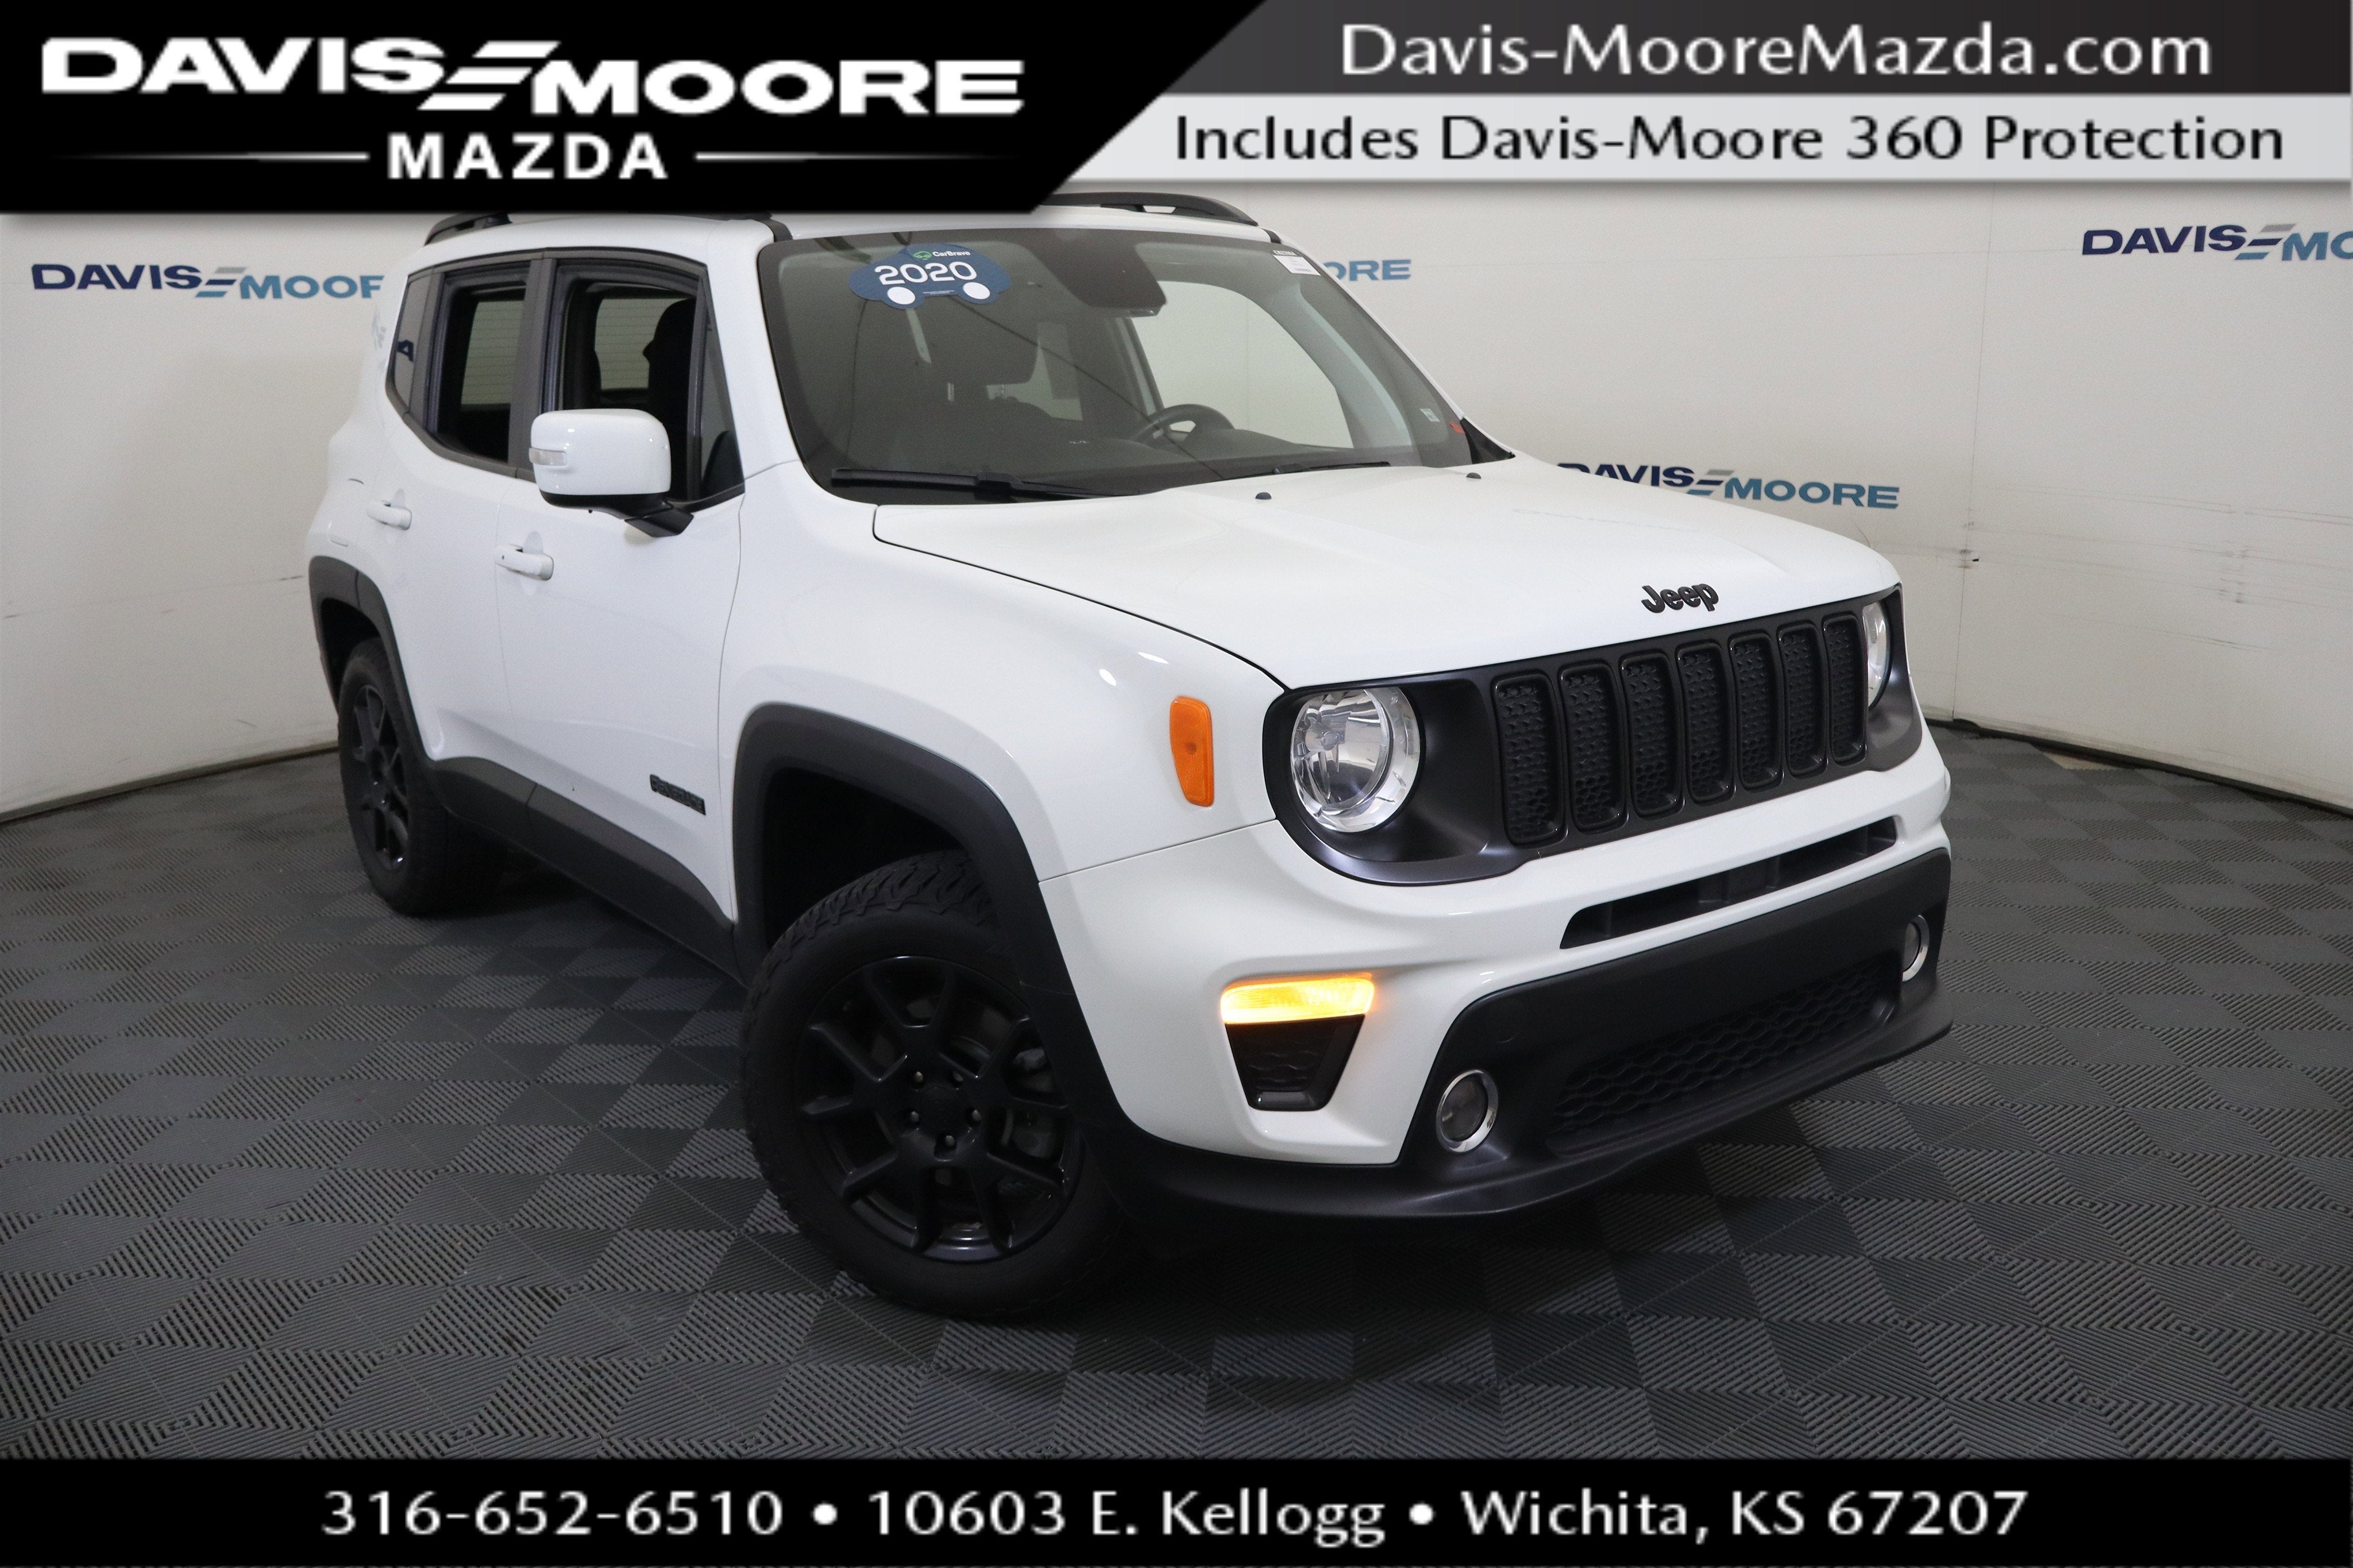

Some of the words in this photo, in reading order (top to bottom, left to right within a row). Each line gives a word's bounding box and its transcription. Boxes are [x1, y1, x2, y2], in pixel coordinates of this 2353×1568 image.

[2082, 224, 2247, 255] DAVIS
[31, 264, 202, 289] DAVIS
[875, 261, 977, 285] 2020
[1725, 477, 1899, 509] MOORE
[1641, 584, 1719, 613] Jeep
